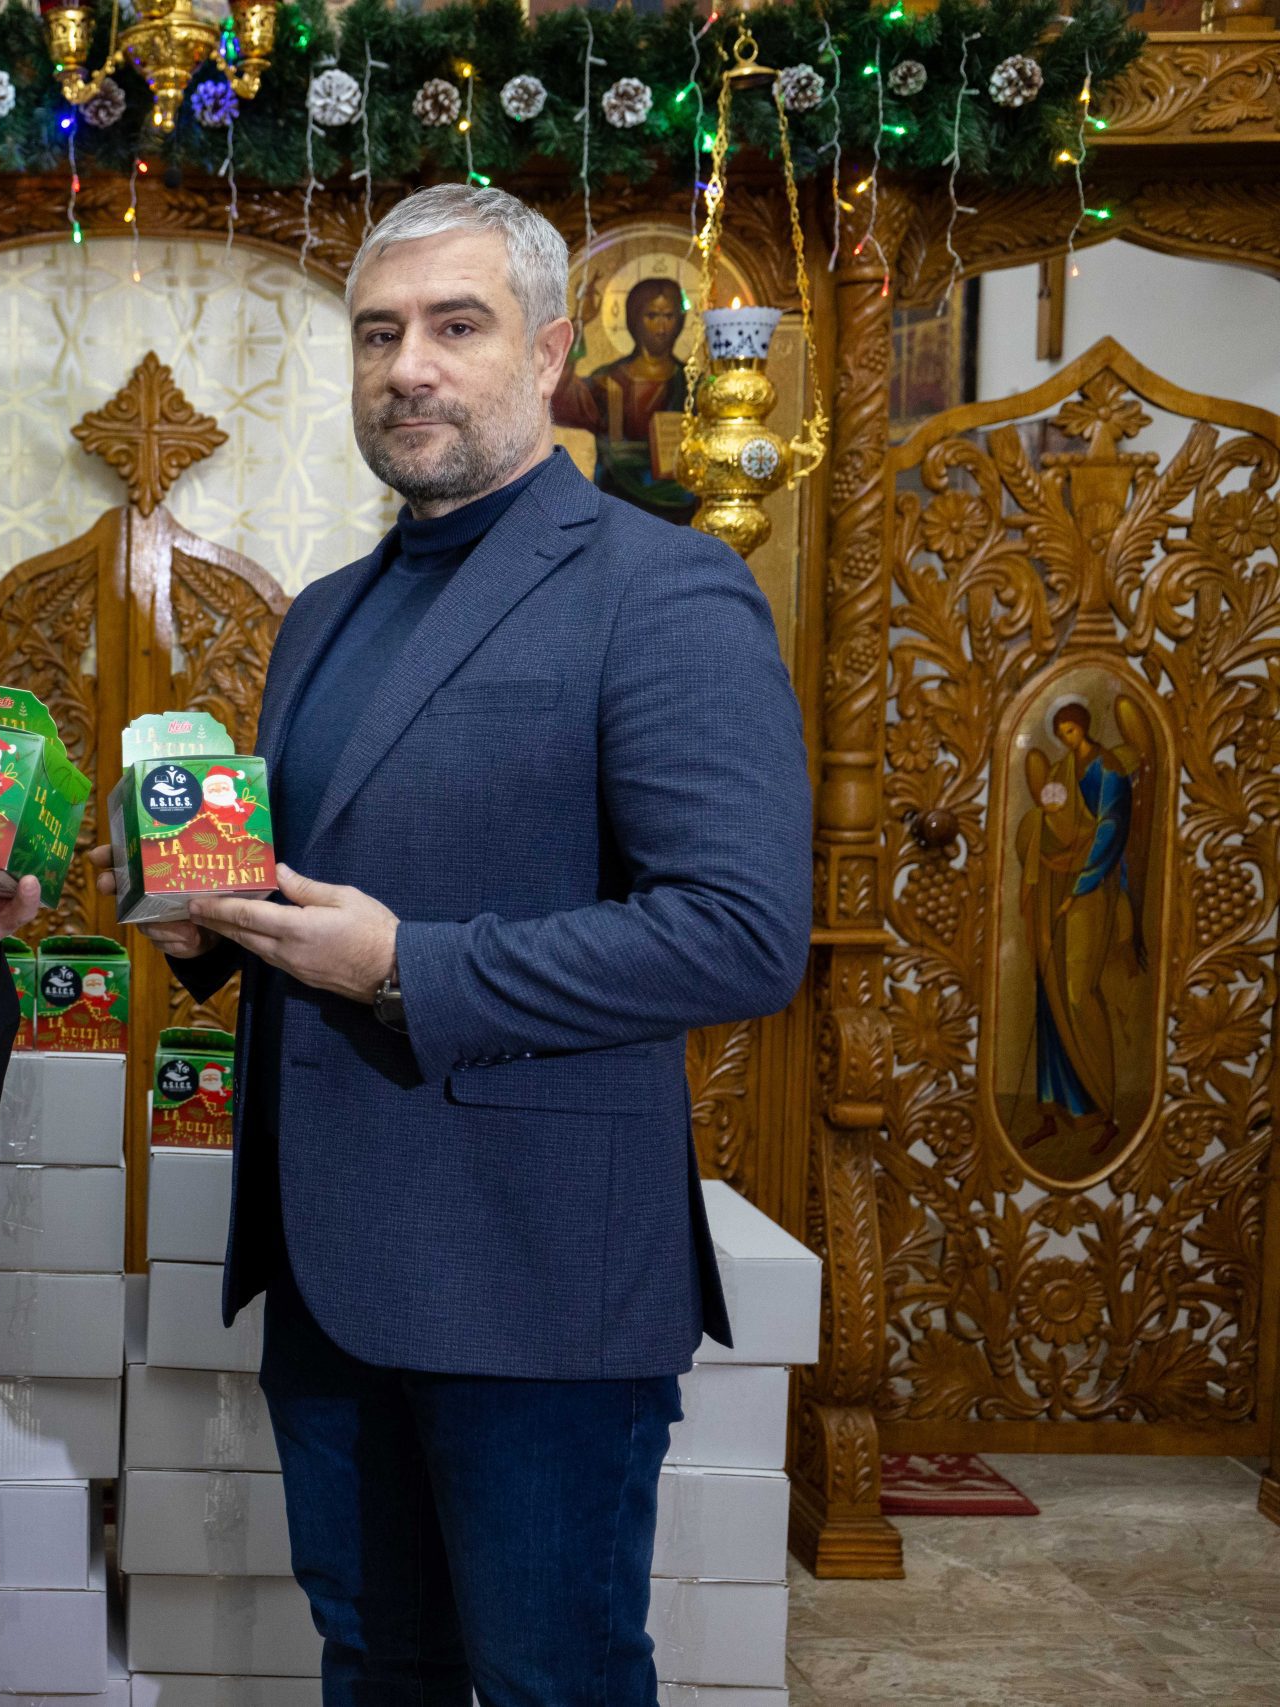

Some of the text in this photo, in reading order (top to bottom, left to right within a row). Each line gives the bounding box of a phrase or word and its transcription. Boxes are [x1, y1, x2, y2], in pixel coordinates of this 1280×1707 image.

[158, 838, 184, 857] LA
[177, 853, 235, 870] MULTI
[226, 866, 265, 886] ANI!
